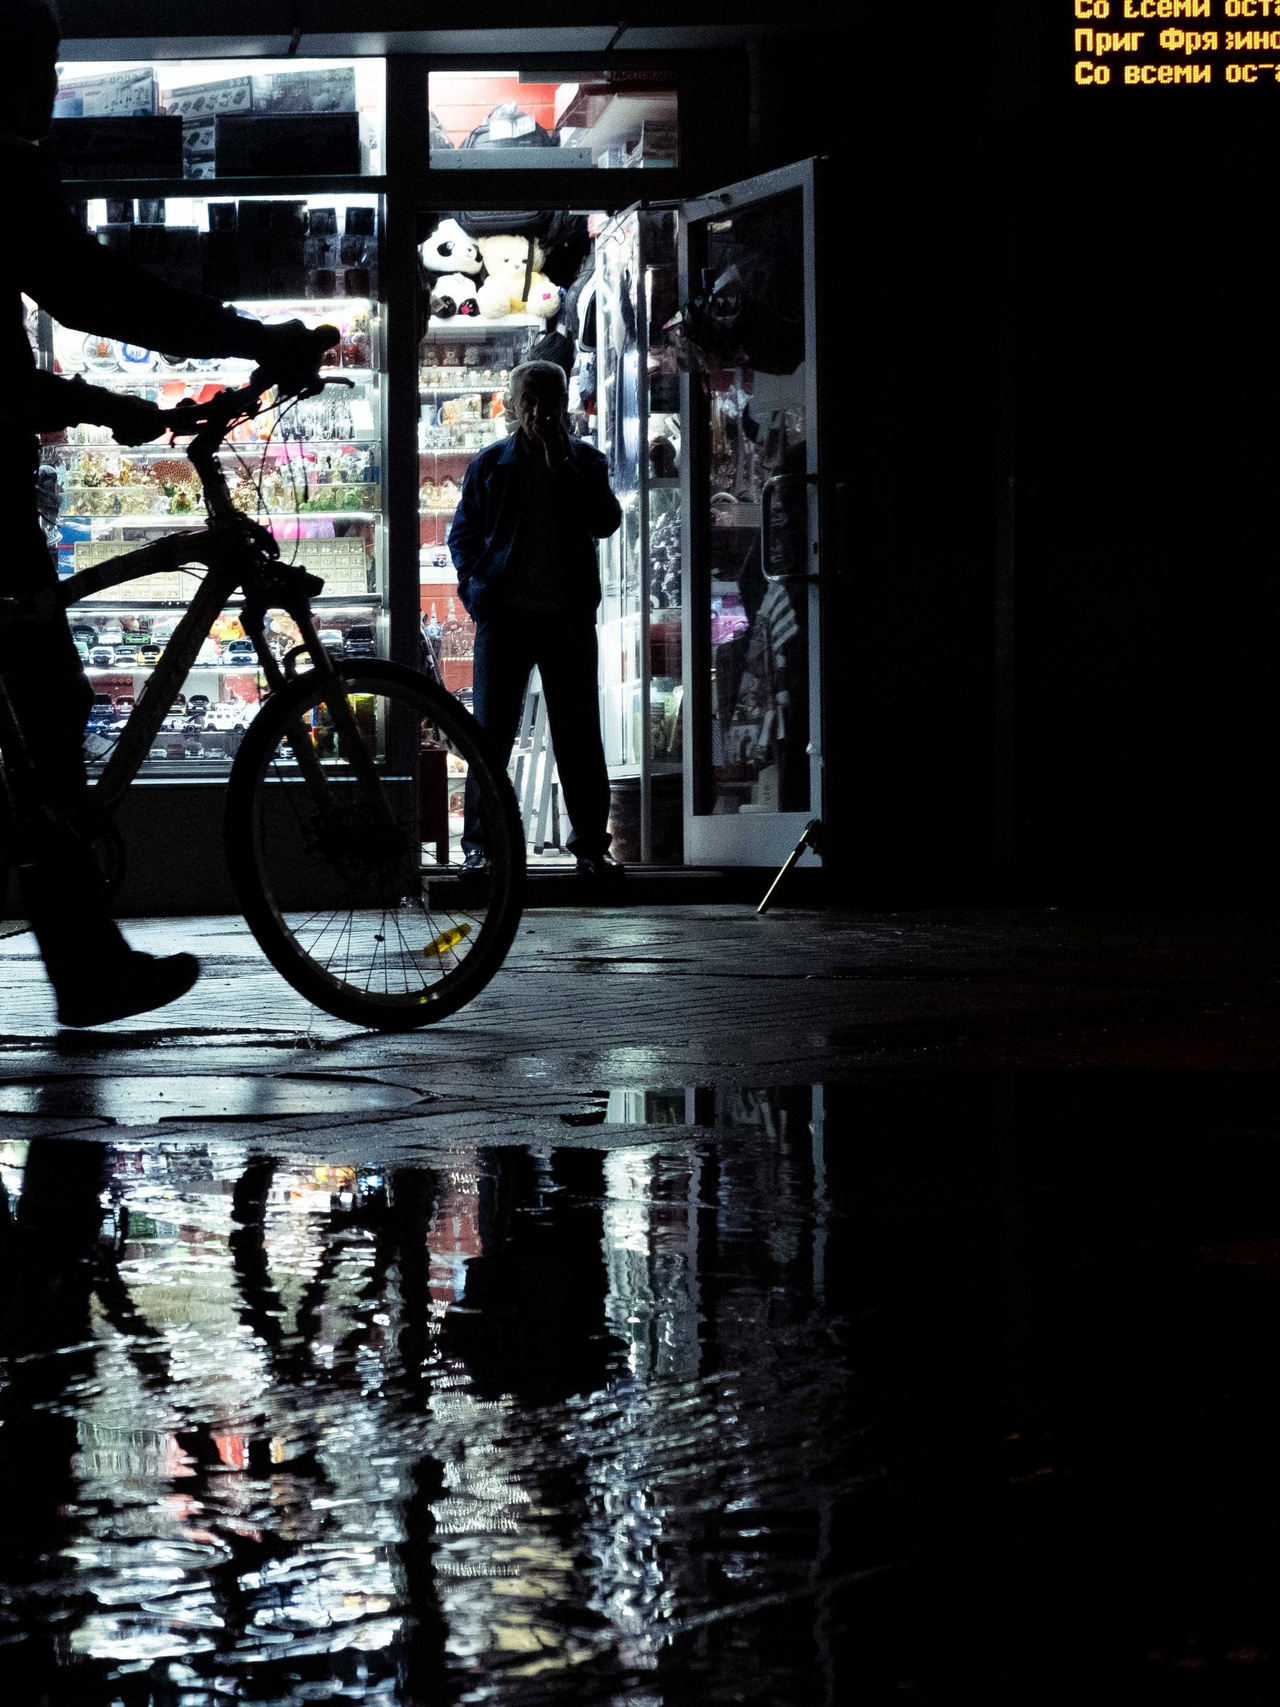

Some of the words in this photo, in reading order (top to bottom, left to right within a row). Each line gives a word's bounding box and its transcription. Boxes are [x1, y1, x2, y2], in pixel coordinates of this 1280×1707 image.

[1074, 0, 1111, 19] Со
[1074, 27, 1145, 56] Приг
[1074, 61, 1111, 85] Со
[1124, 65, 1211, 84] всеми
[1225, 64, 1280, 84] ос
